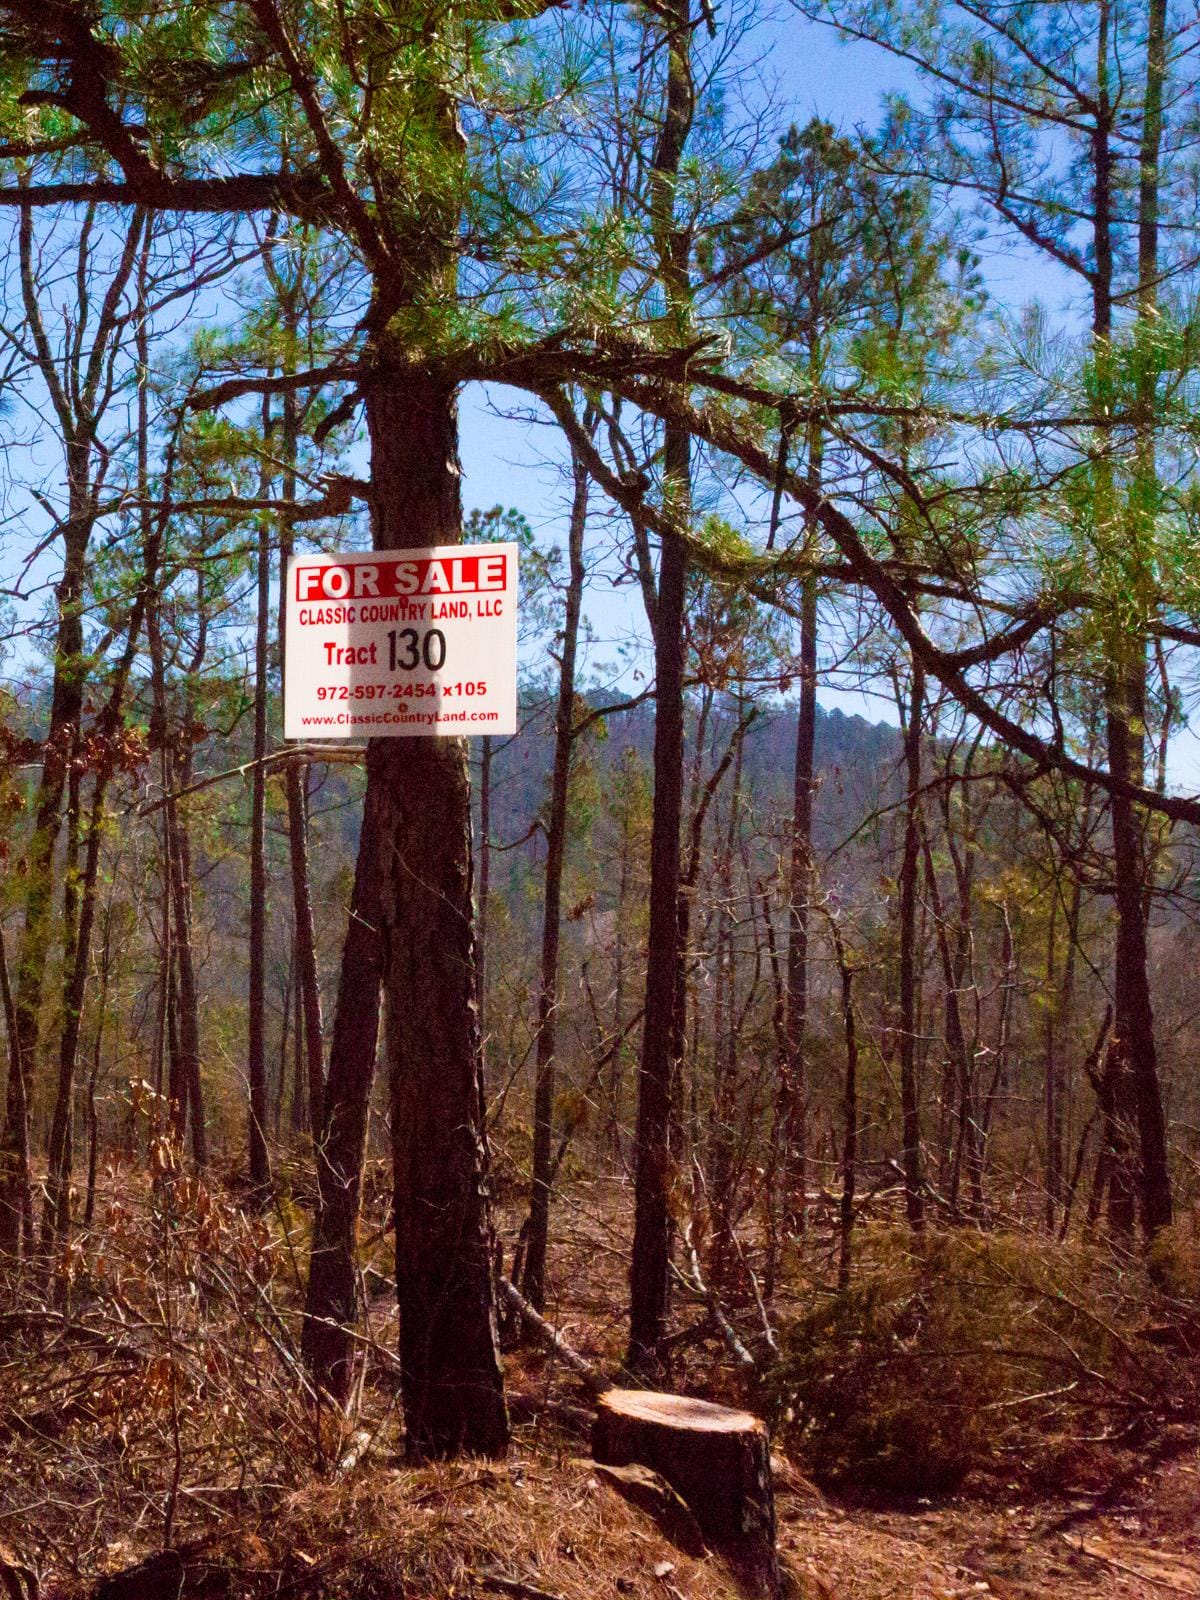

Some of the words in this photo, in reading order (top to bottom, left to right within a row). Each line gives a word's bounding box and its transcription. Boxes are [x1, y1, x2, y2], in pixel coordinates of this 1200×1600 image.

[298, 566, 380, 600] FOR
[394, 557, 504, 595] SALE
[299, 607, 356, 625] CLASSIC
[360, 603, 427, 623] COUNTRY
[431, 601, 472, 622] LAND,
[477, 599, 503, 617] LLC
[324, 642, 377, 665] Tract
[387, 628, 446, 671] 130
[317, 683, 436, 700] 972-597-2454
[443, 681, 487, 697] x105
[302, 710, 499, 726] www.ClassicCountryLand.com
